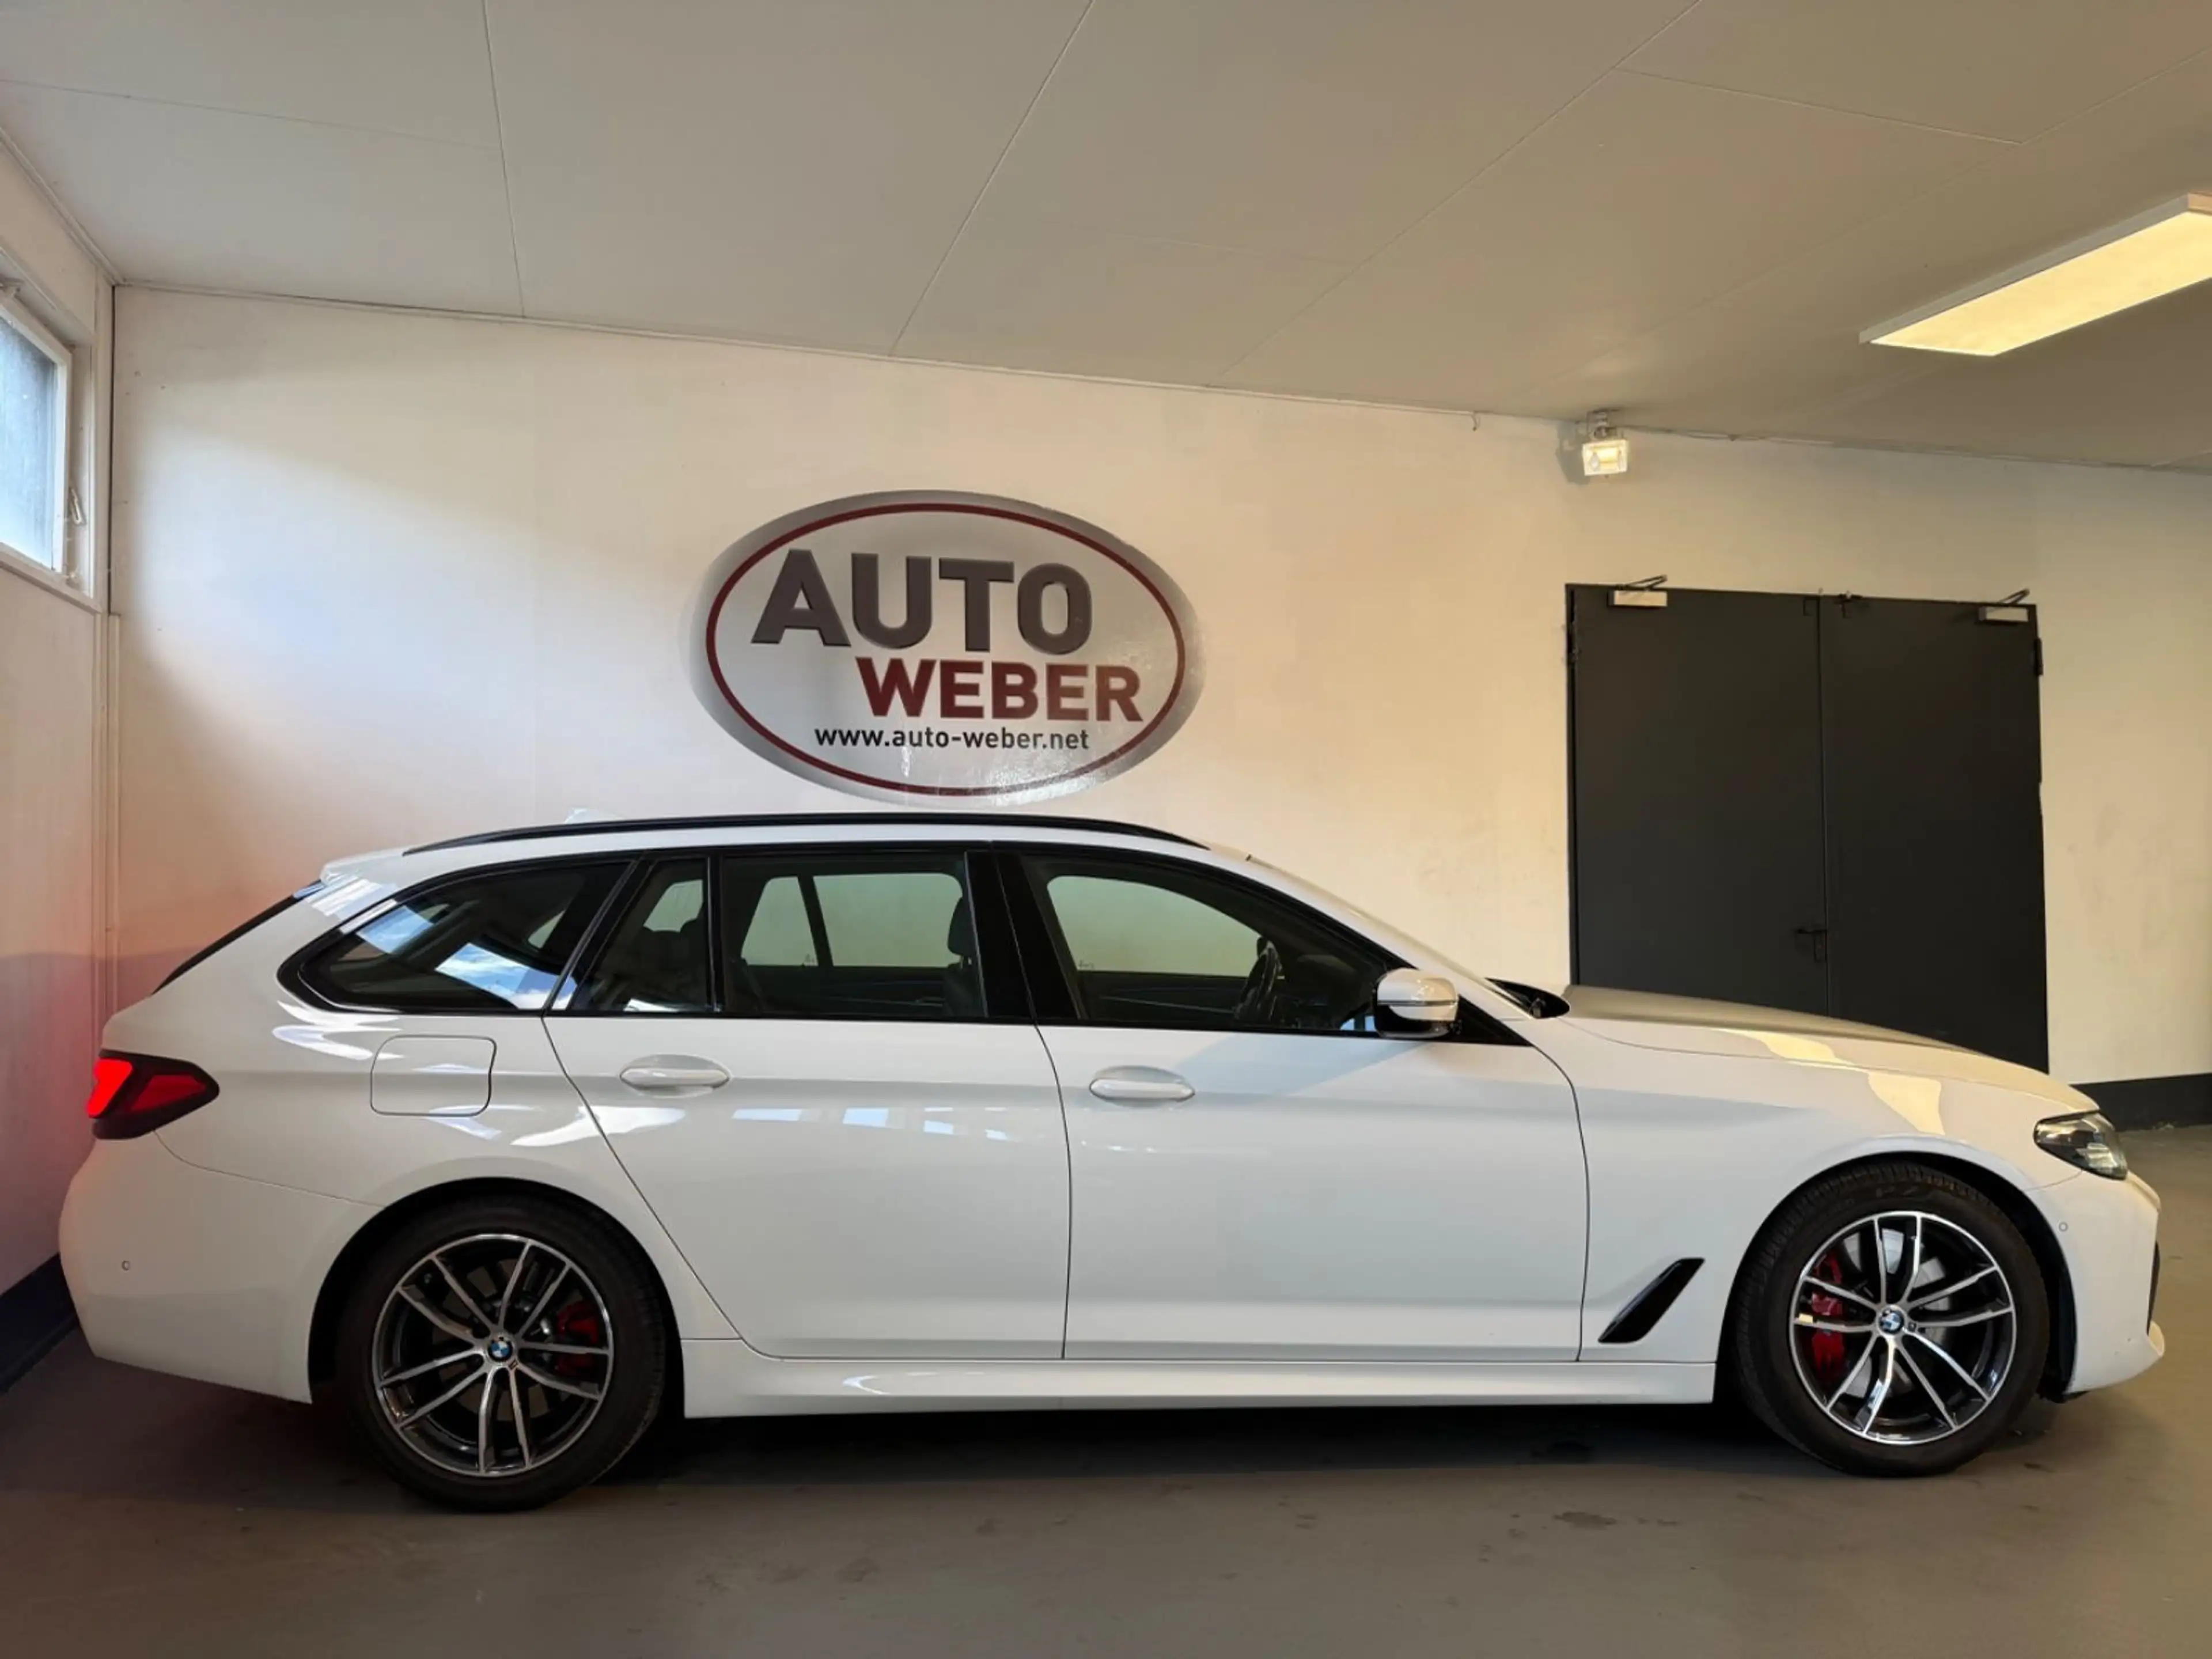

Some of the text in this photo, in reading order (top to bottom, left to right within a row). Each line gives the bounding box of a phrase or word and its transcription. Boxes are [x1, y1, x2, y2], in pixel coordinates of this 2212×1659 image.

[751, 549, 1092, 655] AUTO
[856, 657, 1143, 722] WEBER
[815, 727, 1089, 750] www.auto-weber.net
